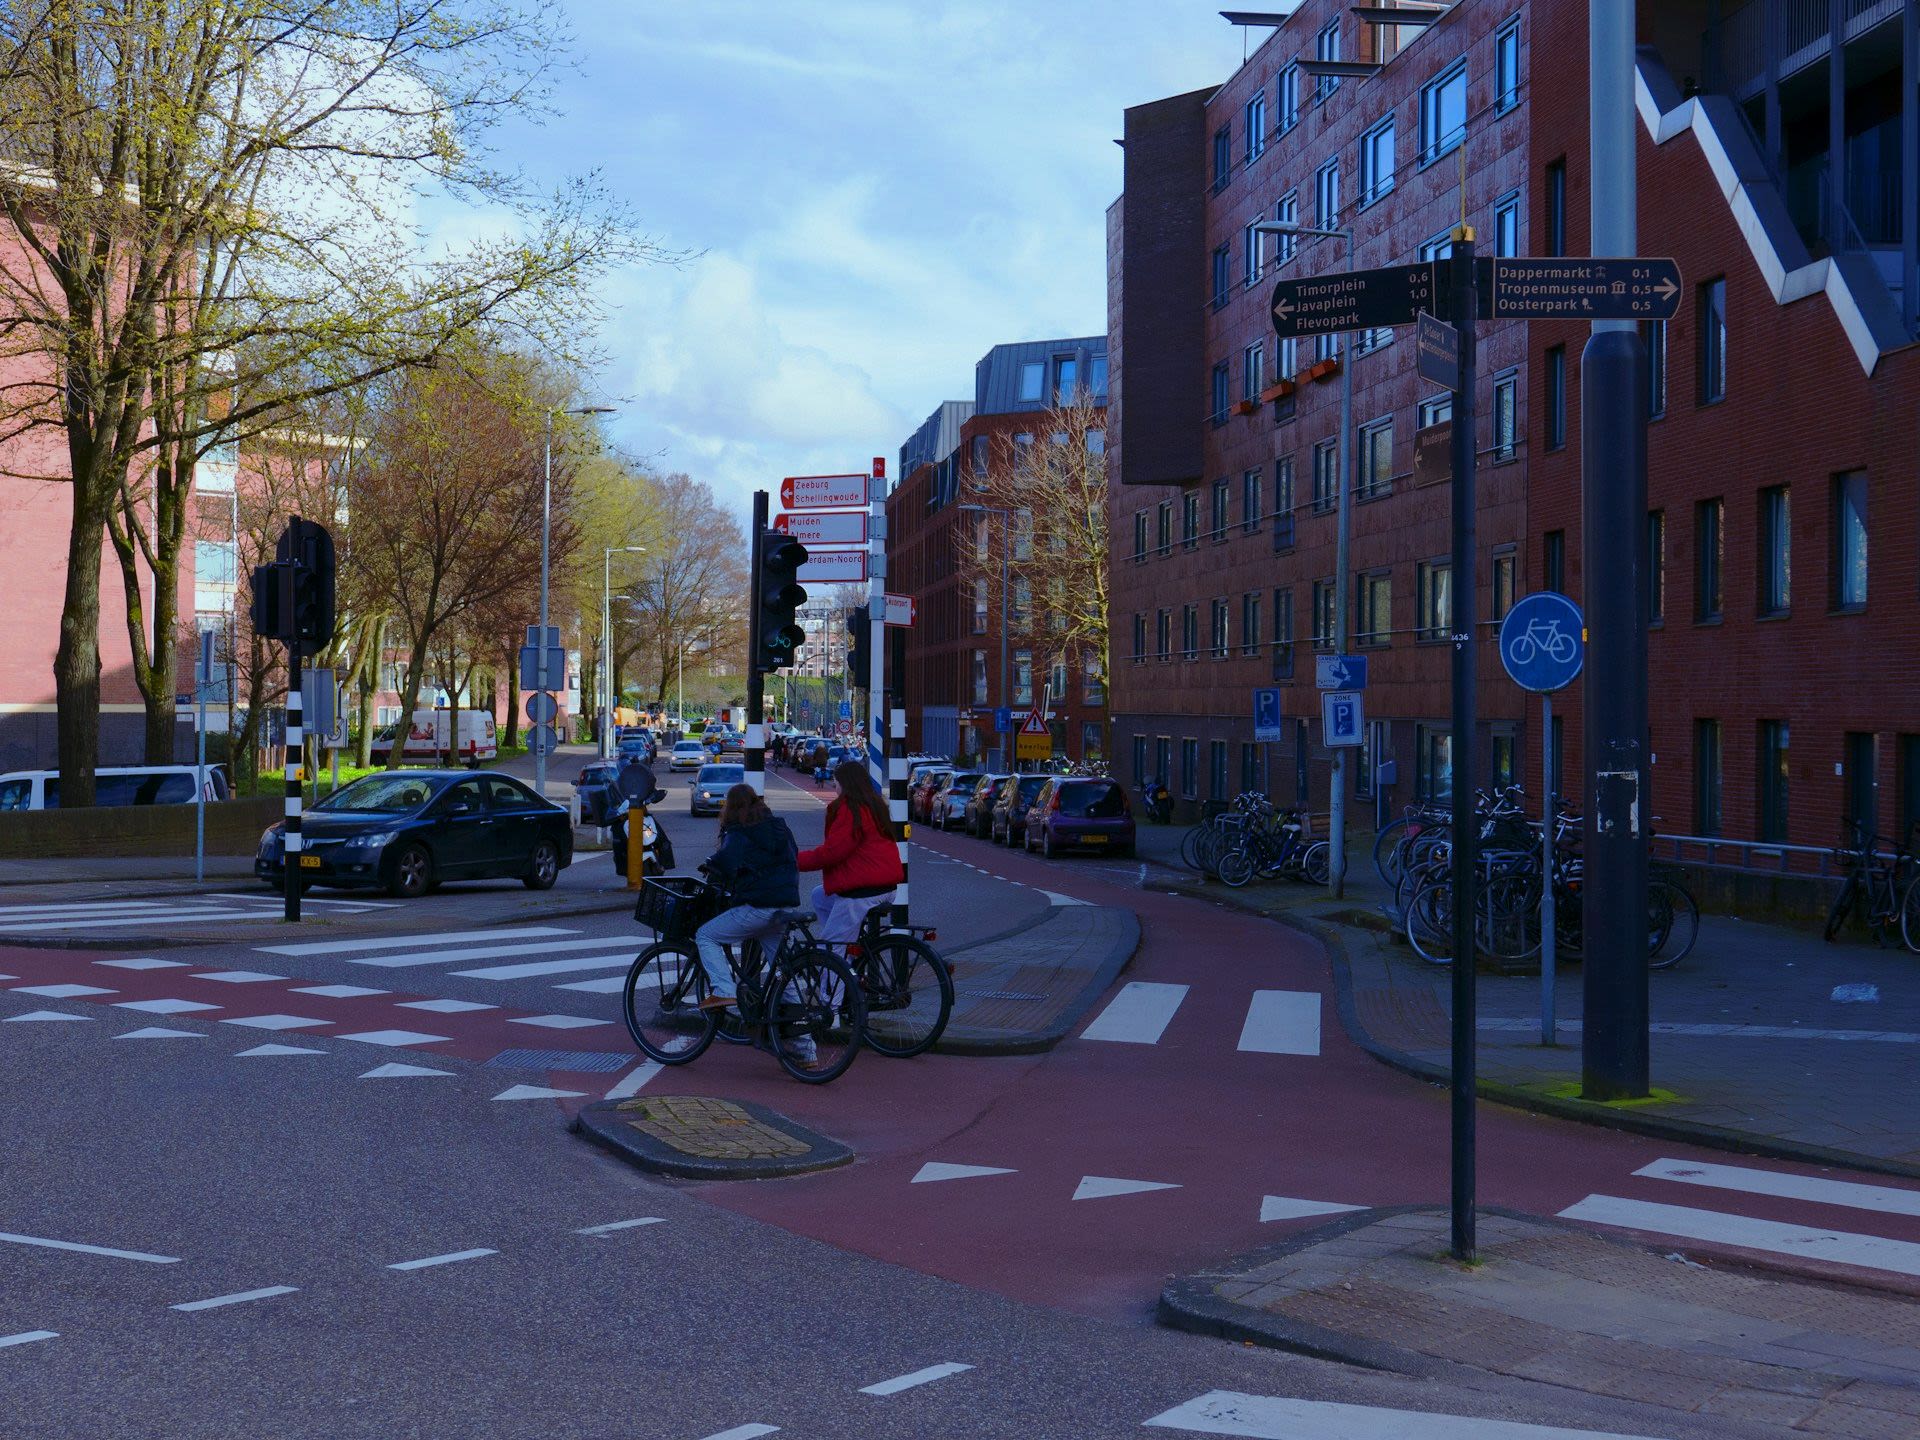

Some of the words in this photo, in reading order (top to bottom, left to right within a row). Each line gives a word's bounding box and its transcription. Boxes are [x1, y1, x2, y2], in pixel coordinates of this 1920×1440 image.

[1499, 266, 1591, 281] Dappermarkt
[1632, 268, 1650, 280] 0,1
[1296, 278, 1367, 298] Timorplein
[1409, 272, 1429, 284] 0,6
[1499, 282, 1607, 297] Tropenmuseum
[1631, 284, 1651, 296] 0,5
[1296, 295, 1356, 313] Javaplein
[1409, 288, 1428, 300] 1,0
[1499, 298, 1577, 312] Oosterpark
[1632, 301, 1651, 312] 0,5
[1296, 312, 1360, 330] Flevopark
[795, 481, 829, 490] Zeeburg
[795, 493, 859, 503] Schellingwoude
[789, 518, 820, 526] Muiden
[791, 531, 820, 539] Almere
[1456, 642, 1462, 650] 9
